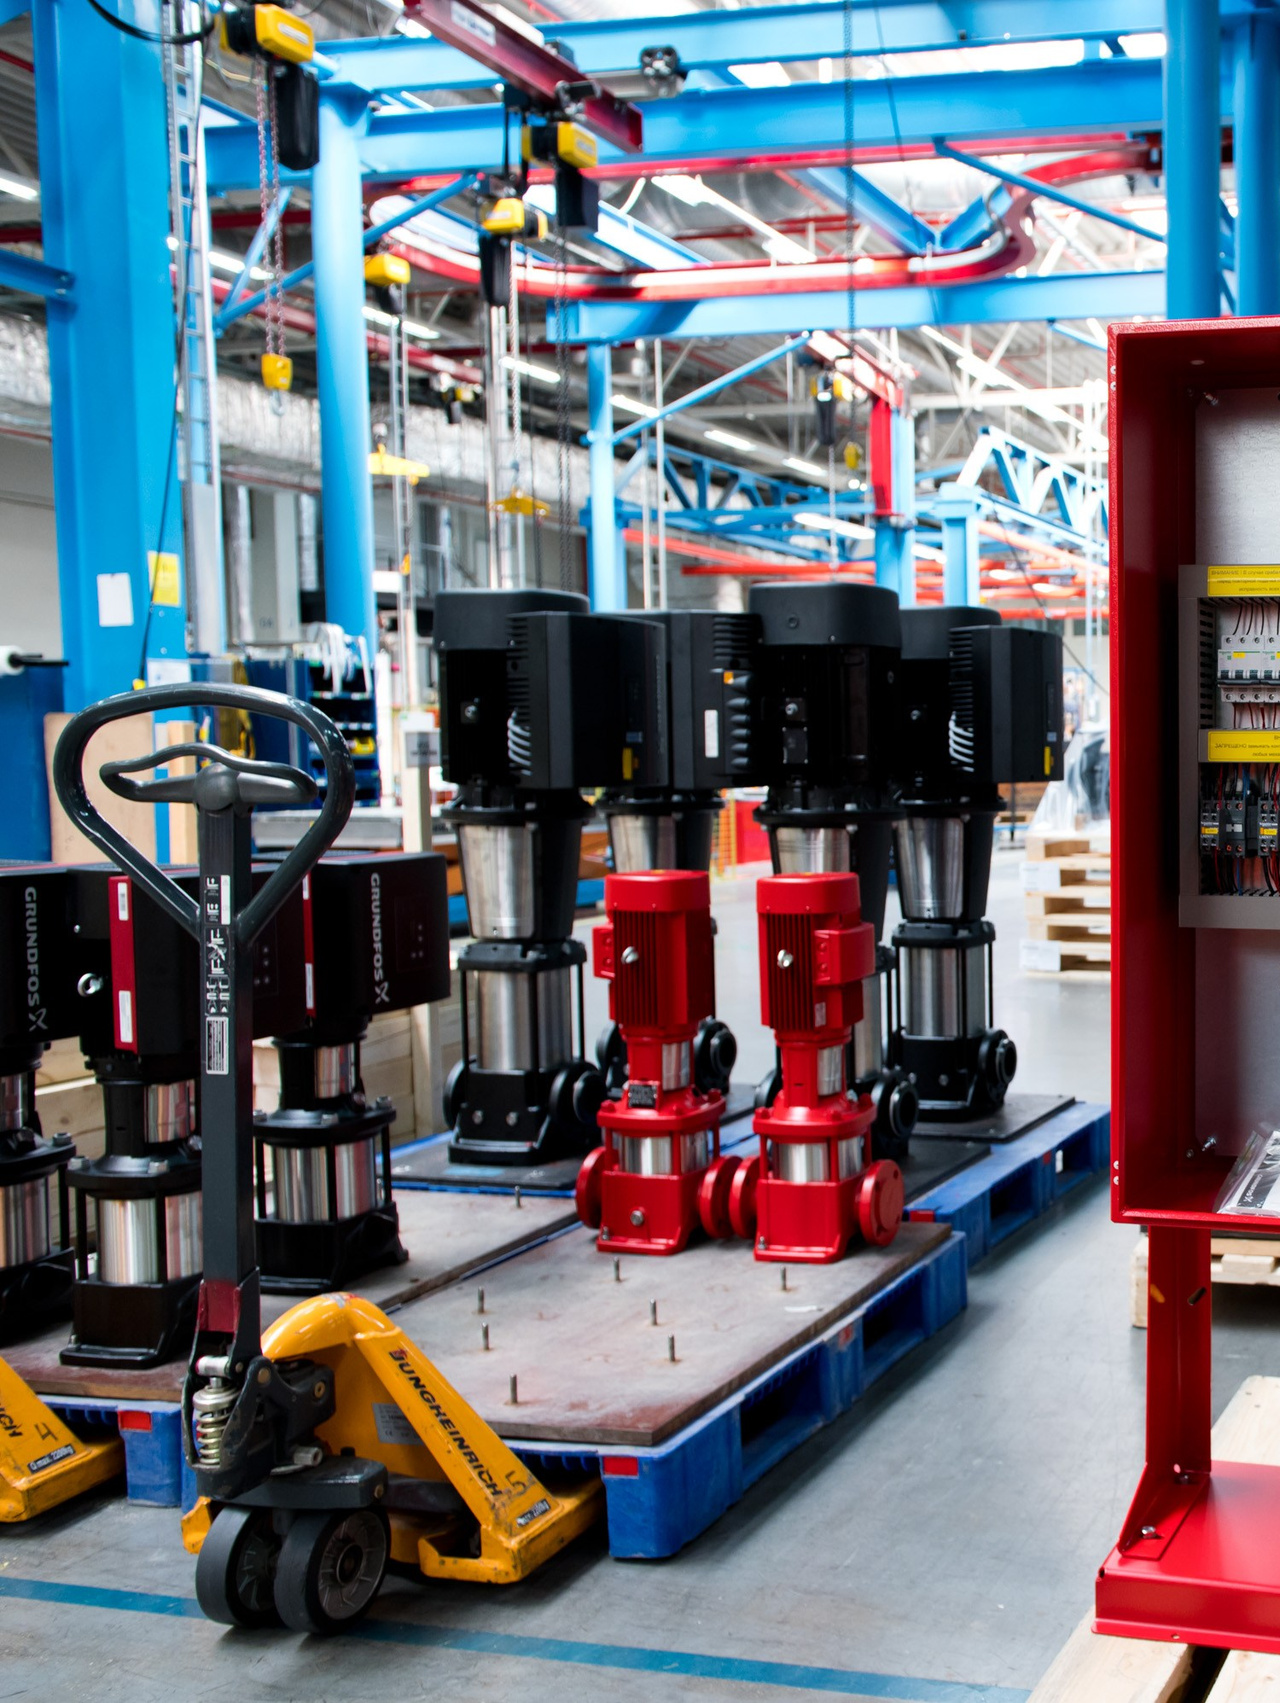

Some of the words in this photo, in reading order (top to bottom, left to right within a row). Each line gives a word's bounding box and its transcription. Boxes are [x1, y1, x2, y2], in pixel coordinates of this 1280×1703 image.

[25, 887, 40, 1007] GRUNDFOS
[371, 873, 383, 982] GRUNDFOS
[34, 1422, 58, 1441] 4
[389, 1349, 503, 1497] JUNGHEINRICH
